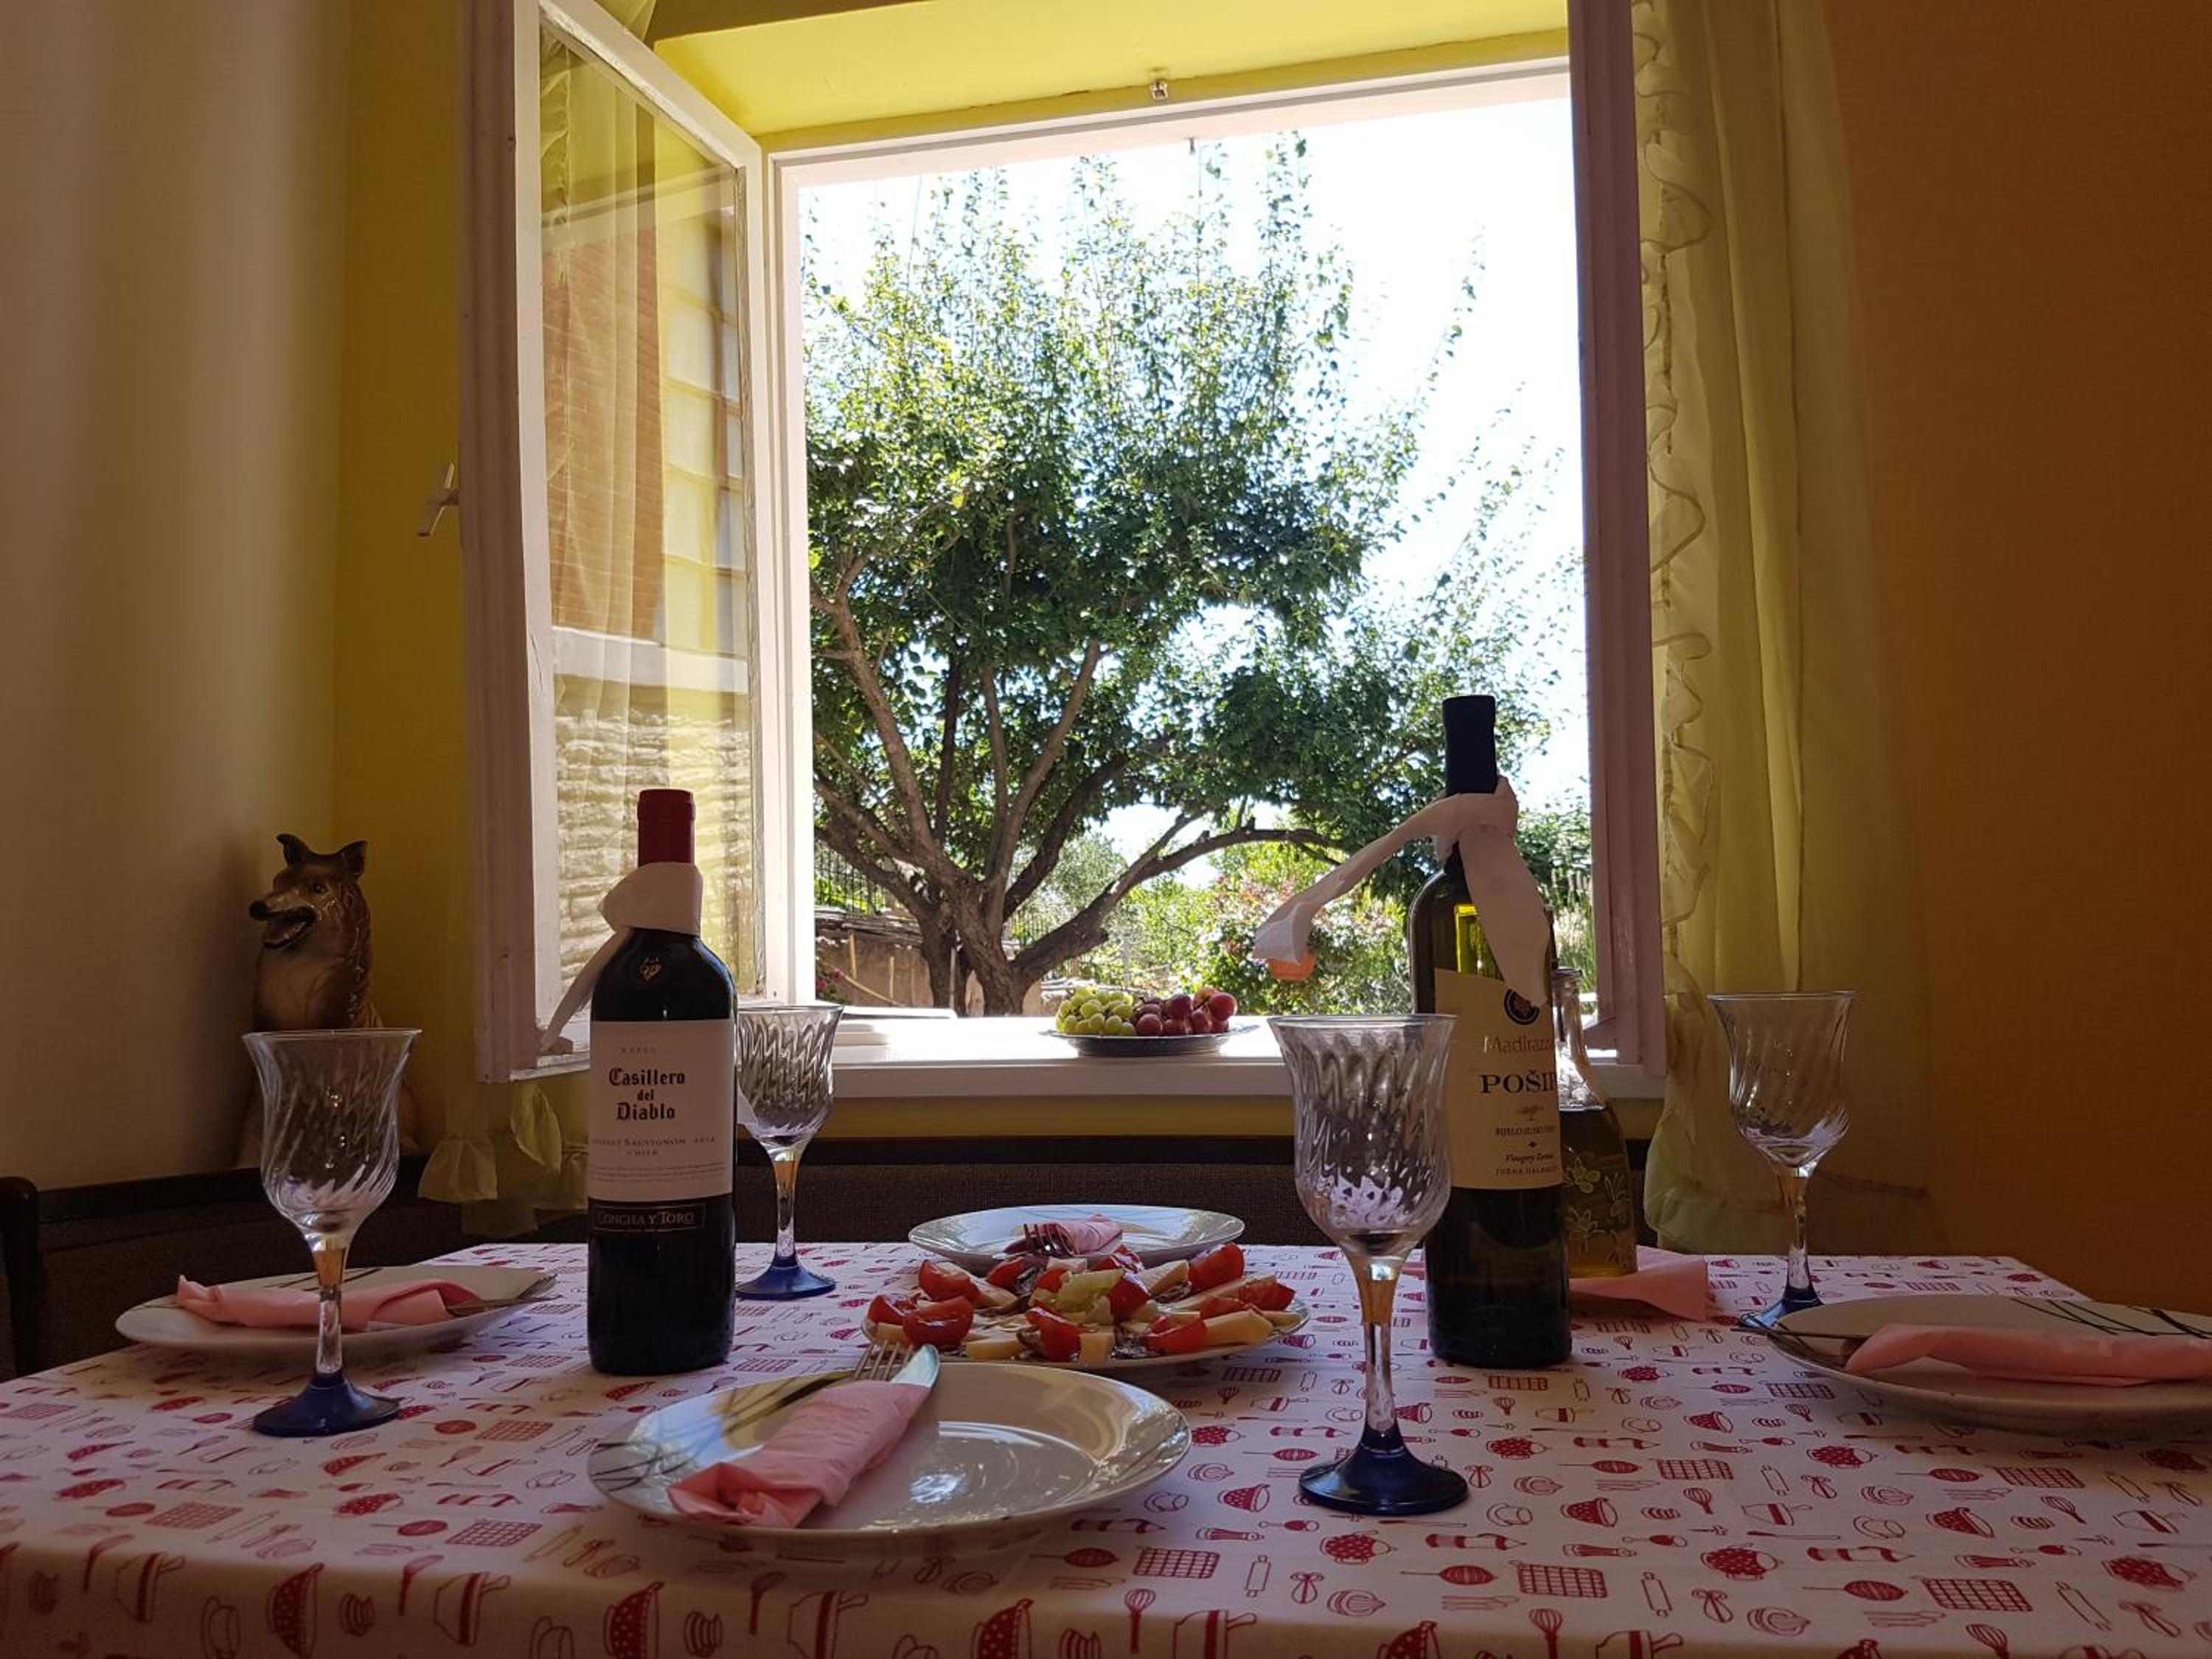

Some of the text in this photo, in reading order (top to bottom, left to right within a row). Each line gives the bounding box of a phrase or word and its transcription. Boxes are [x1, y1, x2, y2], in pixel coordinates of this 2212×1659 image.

[608, 1067, 686, 1086] Casillero
[637, 1089, 654, 1101] del
[616, 1102, 675, 1121] Diablo
